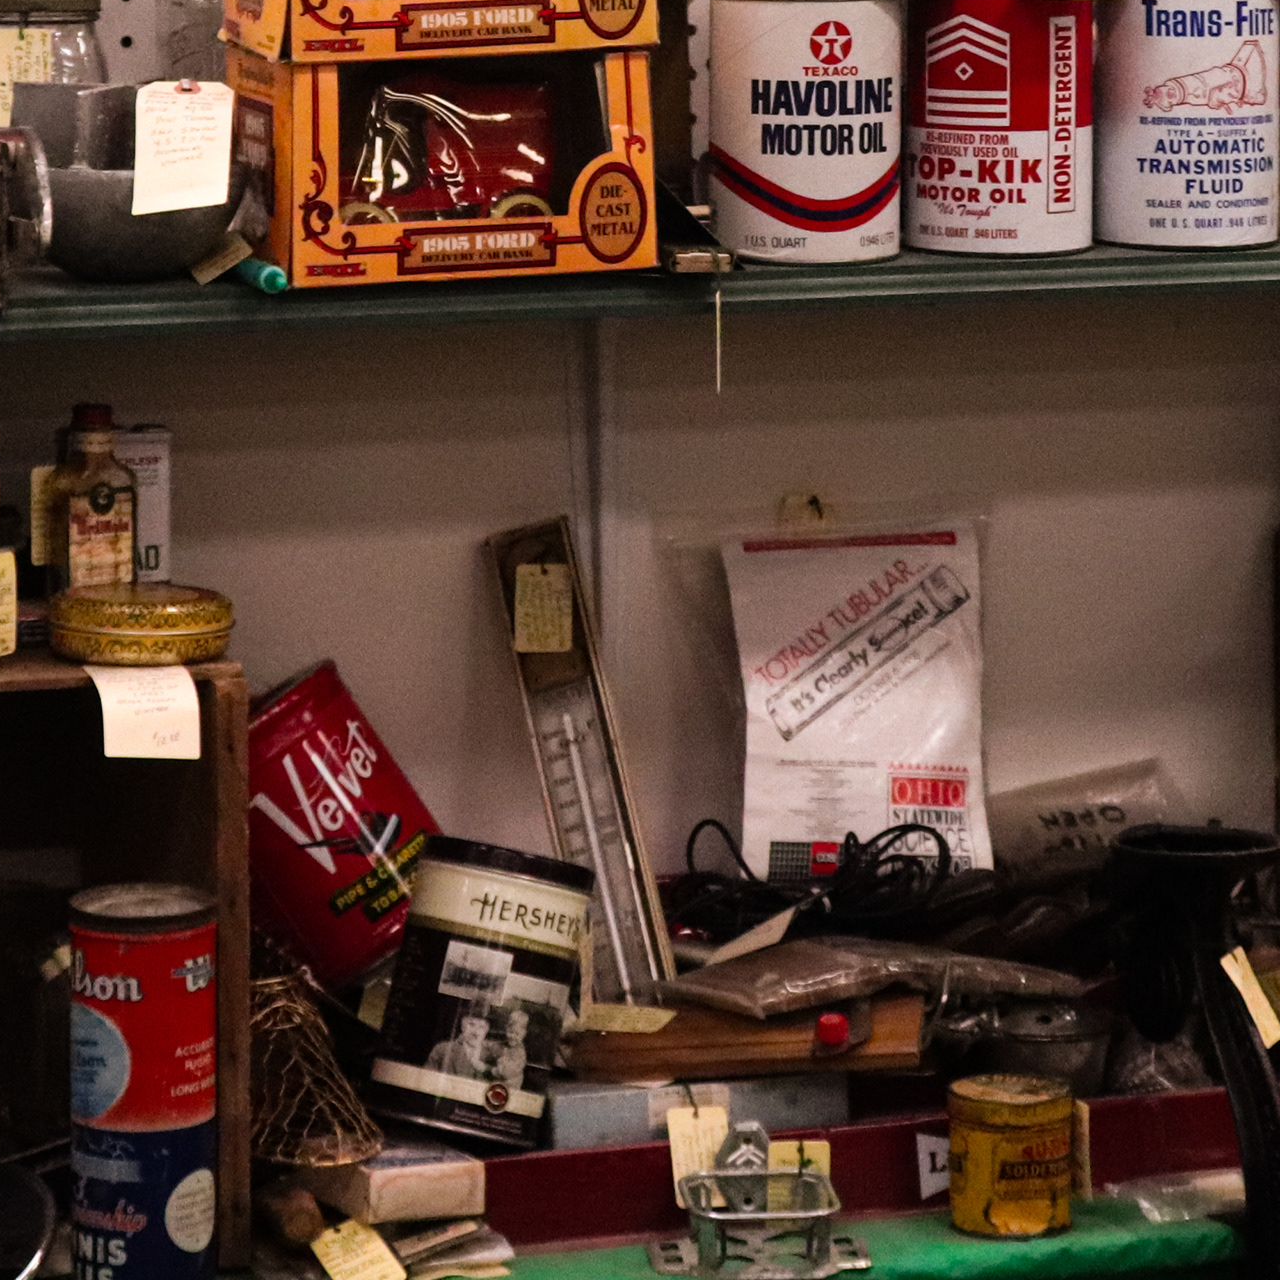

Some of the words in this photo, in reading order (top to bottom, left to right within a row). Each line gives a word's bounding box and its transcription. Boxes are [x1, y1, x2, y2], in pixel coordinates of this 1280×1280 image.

[420, 11, 468, 29] 1905
[474, 7, 535, 25] FORD
[420, 27, 472, 39] DELIVERY
[477, 26, 499, 36] CAR
[502, 24, 533, 35] BANK
[803, 66, 859, 77] TEXACO
[751, 77, 893, 117] HAVOLINE
[1054, 24, 1073, 204] NON-DETERGENT
[1184, 117, 1206, 126] FROM
[762, 123, 854, 156] MOTOR
[859, 122, 887, 154] OIL
[926, 132, 975, 145] RE-REFINED
[979, 134, 1009, 145] FROM
[1167, 129, 1190, 138] TYPE
[1218, 129, 1247, 137] SUFFIX
[921, 144, 968, 157] PREVIOUSLY
[973, 147, 998, 157] USED
[1002, 147, 1018, 158] OIL
[1155, 138, 1265, 155] AUTOMATIC
[909, 153, 1042, 183] TOP-KIK
[1137, 157, 1272, 175] TRANSMISSION
[599, 184, 628, 199] DIE-
[916, 184, 980, 203] MOTOR
[990, 188, 1027, 203] OIL
[1186, 179, 1243, 194] FLUID
[595, 203, 631, 218] CAST
[1146, 199, 1182, 208] SEALER
[1188, 200, 1211, 208] AND
[589, 221, 638, 237] METAL
[1149, 218, 1167, 228] ONE
[1195, 219, 1222, 228] QUART
[945, 227, 968, 237] QUART
[990, 229, 1018, 239] LITERS
[422, 237, 471, 253] 1905
[475, 231, 536, 250] FORD
[771, 237, 808, 248] QUART
[420, 252, 474, 265] DELIVERY
[478, 251, 502, 261] CAR
[503, 250, 533, 260] BANK
[754, 620, 831, 684] TOTALLY
[791, 690, 816, 712] It's
[814, 647, 871, 694] Clearly
[249, 719, 379, 875] Velvet
[893, 778, 966, 807] OHIO
[893, 809, 967, 826] STATEWIDE
[335, 884, 366, 910] PIPE
